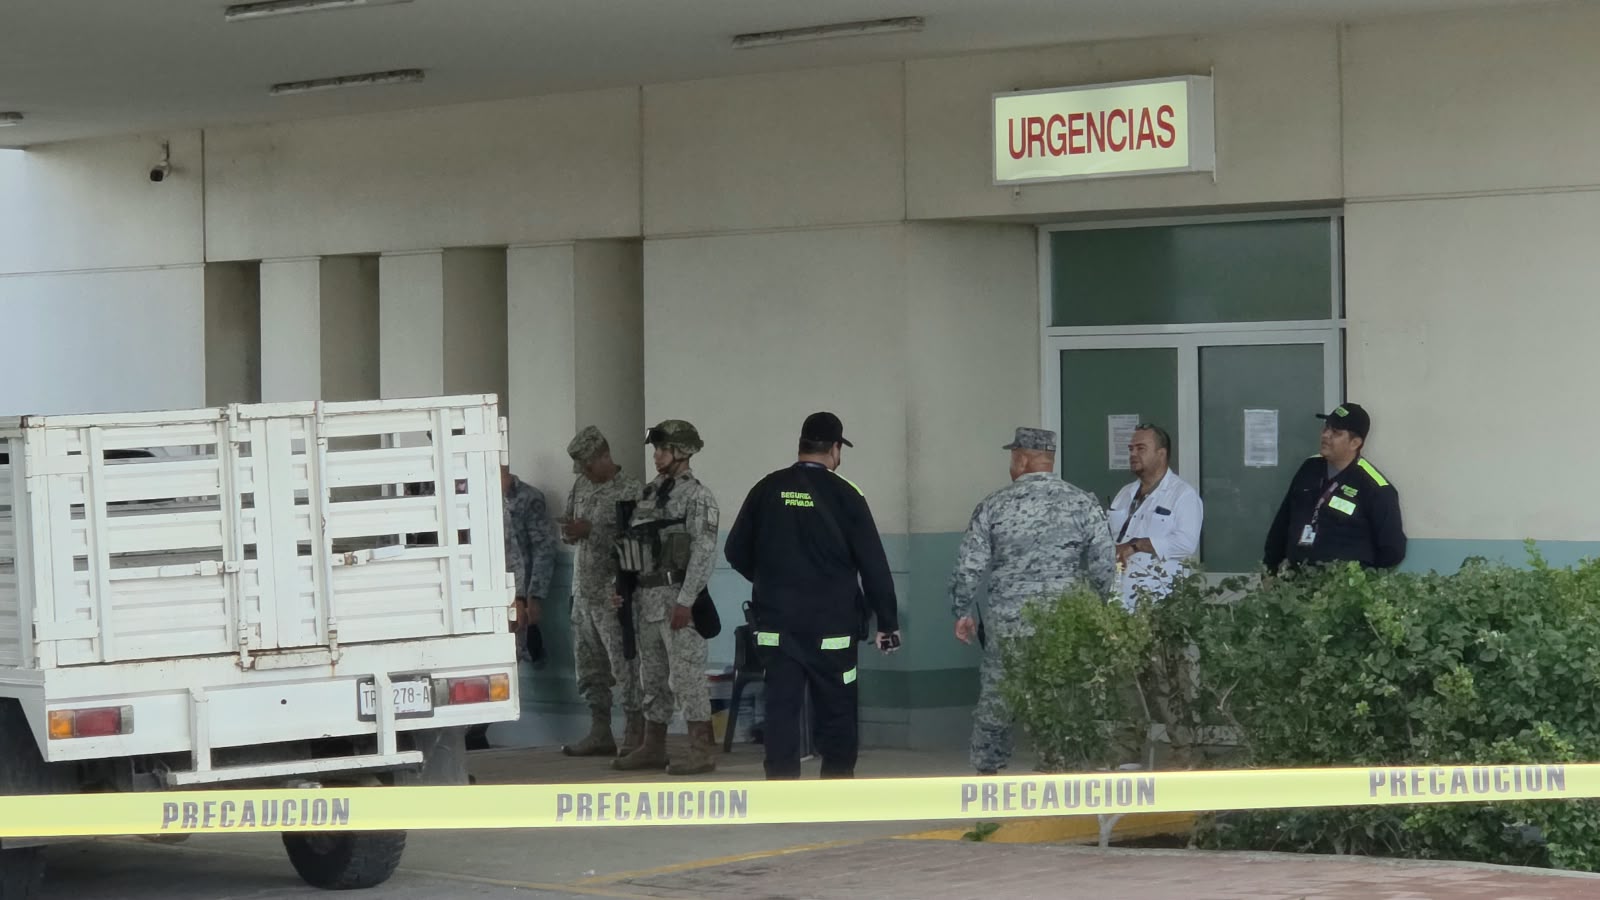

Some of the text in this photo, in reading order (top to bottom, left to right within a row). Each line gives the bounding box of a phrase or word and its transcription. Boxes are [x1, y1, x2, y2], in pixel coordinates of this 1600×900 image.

[1008, 105, 1176, 160] URGENCIAS
[784, 499, 814, 507] PRIVADA
[160, 765, 1566, 829] PRECAUCION PRECAUCION PRECAUCION PRECAUCION
